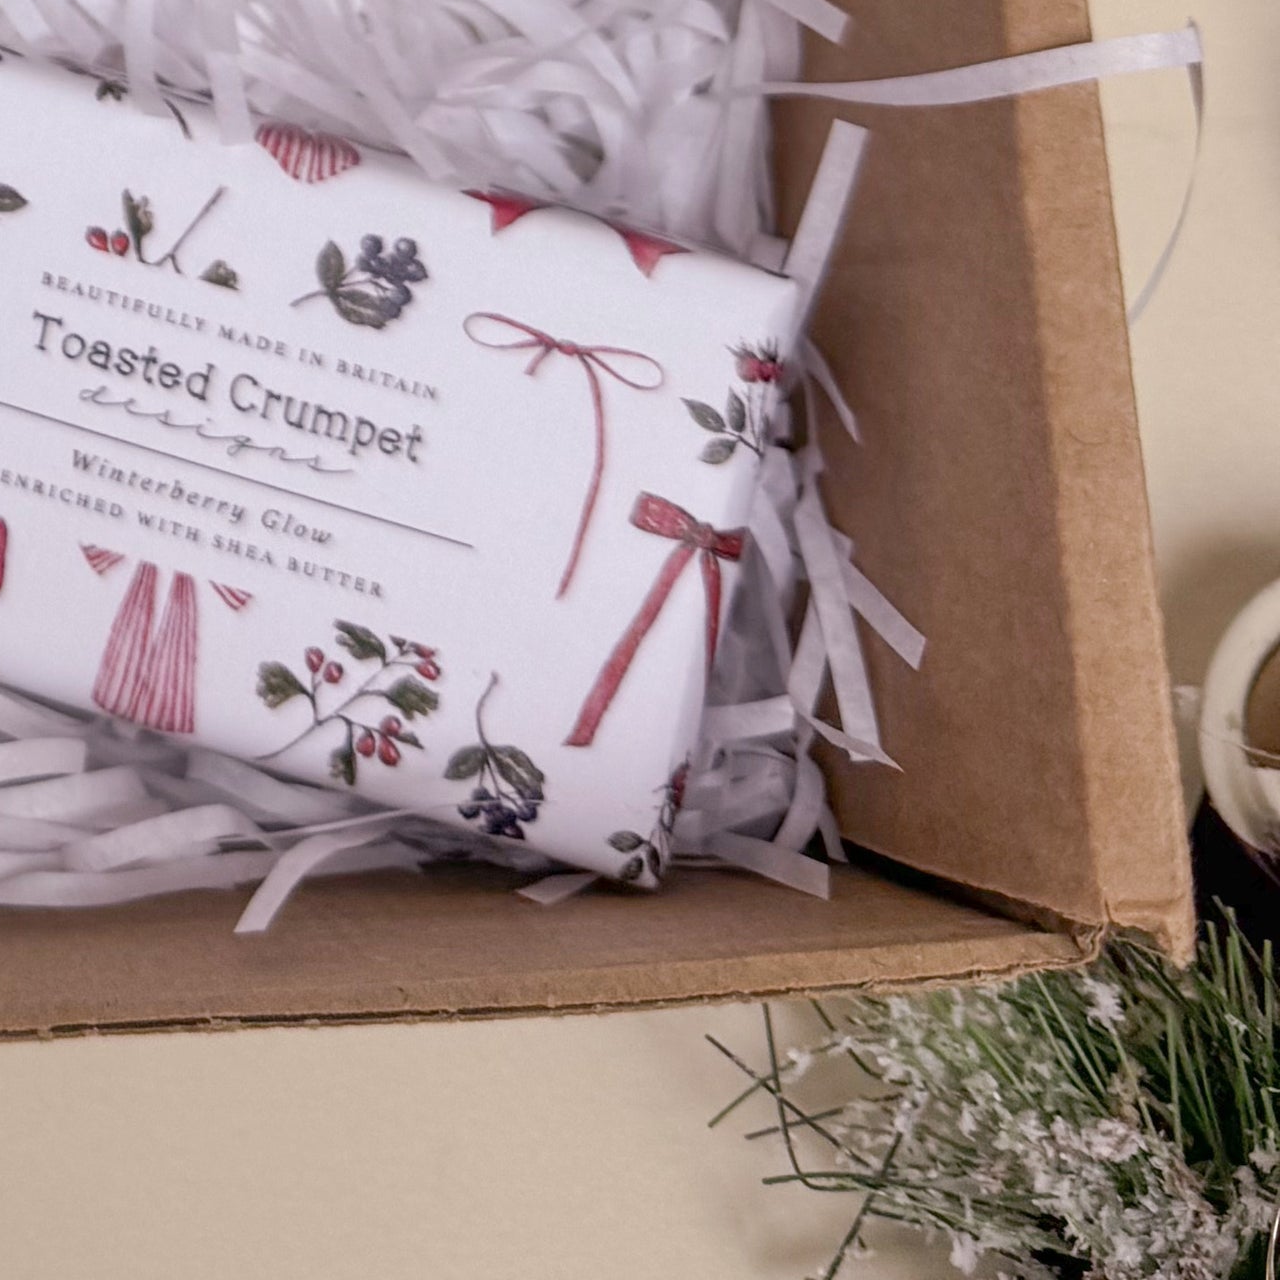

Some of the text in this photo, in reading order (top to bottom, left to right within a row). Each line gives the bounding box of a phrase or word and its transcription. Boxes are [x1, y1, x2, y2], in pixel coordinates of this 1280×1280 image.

[32, 310, 424, 463] Toasted Crumpet
[40, 271, 439, 401] BEAUTIFULLY MADE IN BRITAIN
[78, 384, 355, 474] designs
[0, 468, 384, 599] ENRICHED WITH SHEA BUTTER
[71, 448, 333, 545] Winterberry Glow
